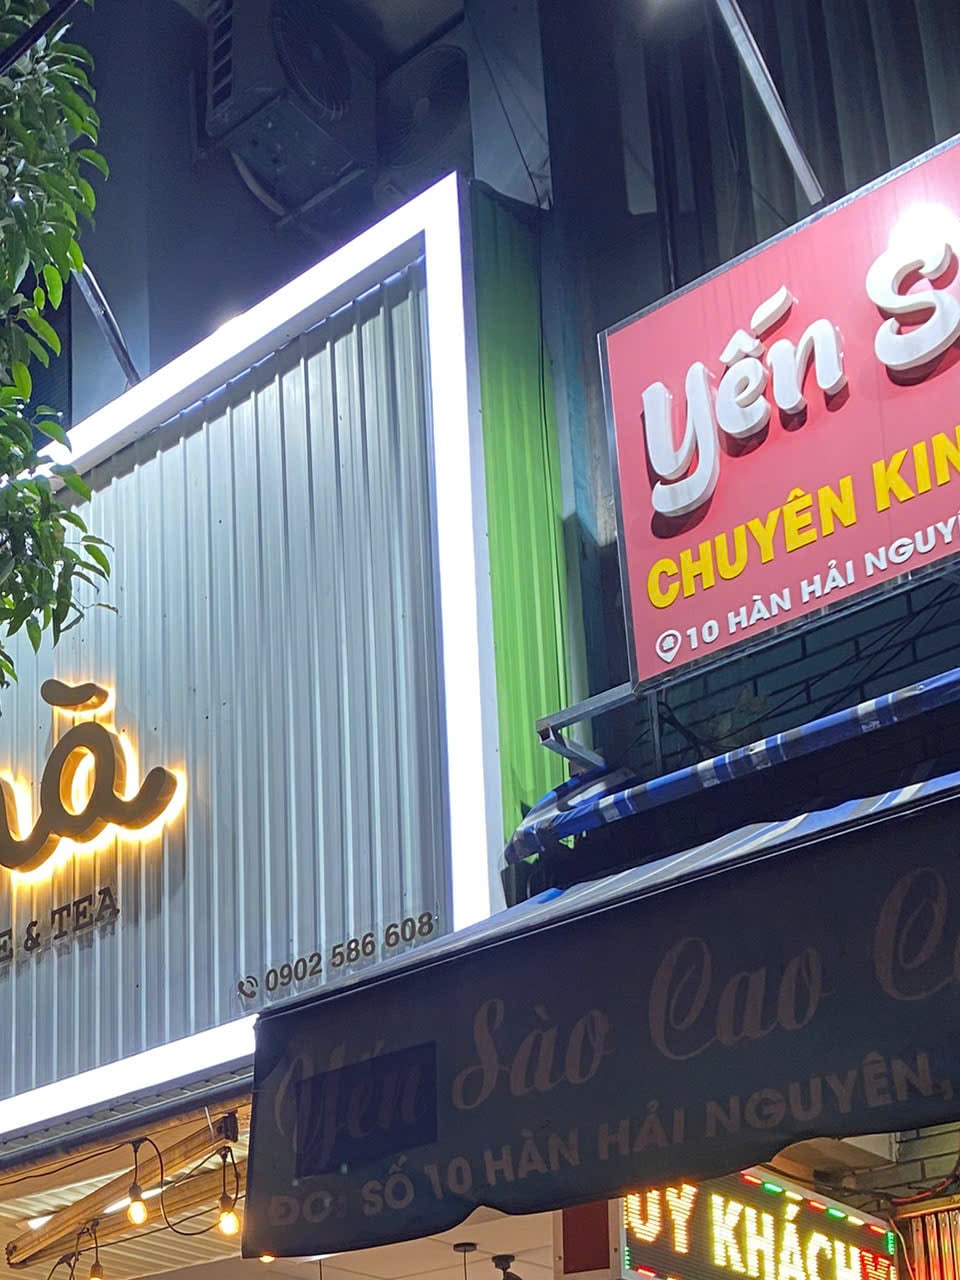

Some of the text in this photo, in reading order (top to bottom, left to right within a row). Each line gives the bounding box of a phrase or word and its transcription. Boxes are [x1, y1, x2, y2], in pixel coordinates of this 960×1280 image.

[642, 285, 847, 517] Yến
[647, 475, 857, 609] CHUYÊN
[686, 509, 960, 651] 10 HÀN HẢI NGUY
[23, 921, 41, 951] &
[51, 886, 121, 940] TEA
[265, 911, 434, 992] 0902 586 608
[452, 998, 615, 1111] Sào
[648, 937, 833, 1061] Cao
[873, 866, 960, 1002] C
[363, 1154, 416, 1217] SỐ
[424, 1156, 473, 1200] 10
[484, 1127, 580, 1187] HÀN
[598, 1099, 685, 1161] HẢI
